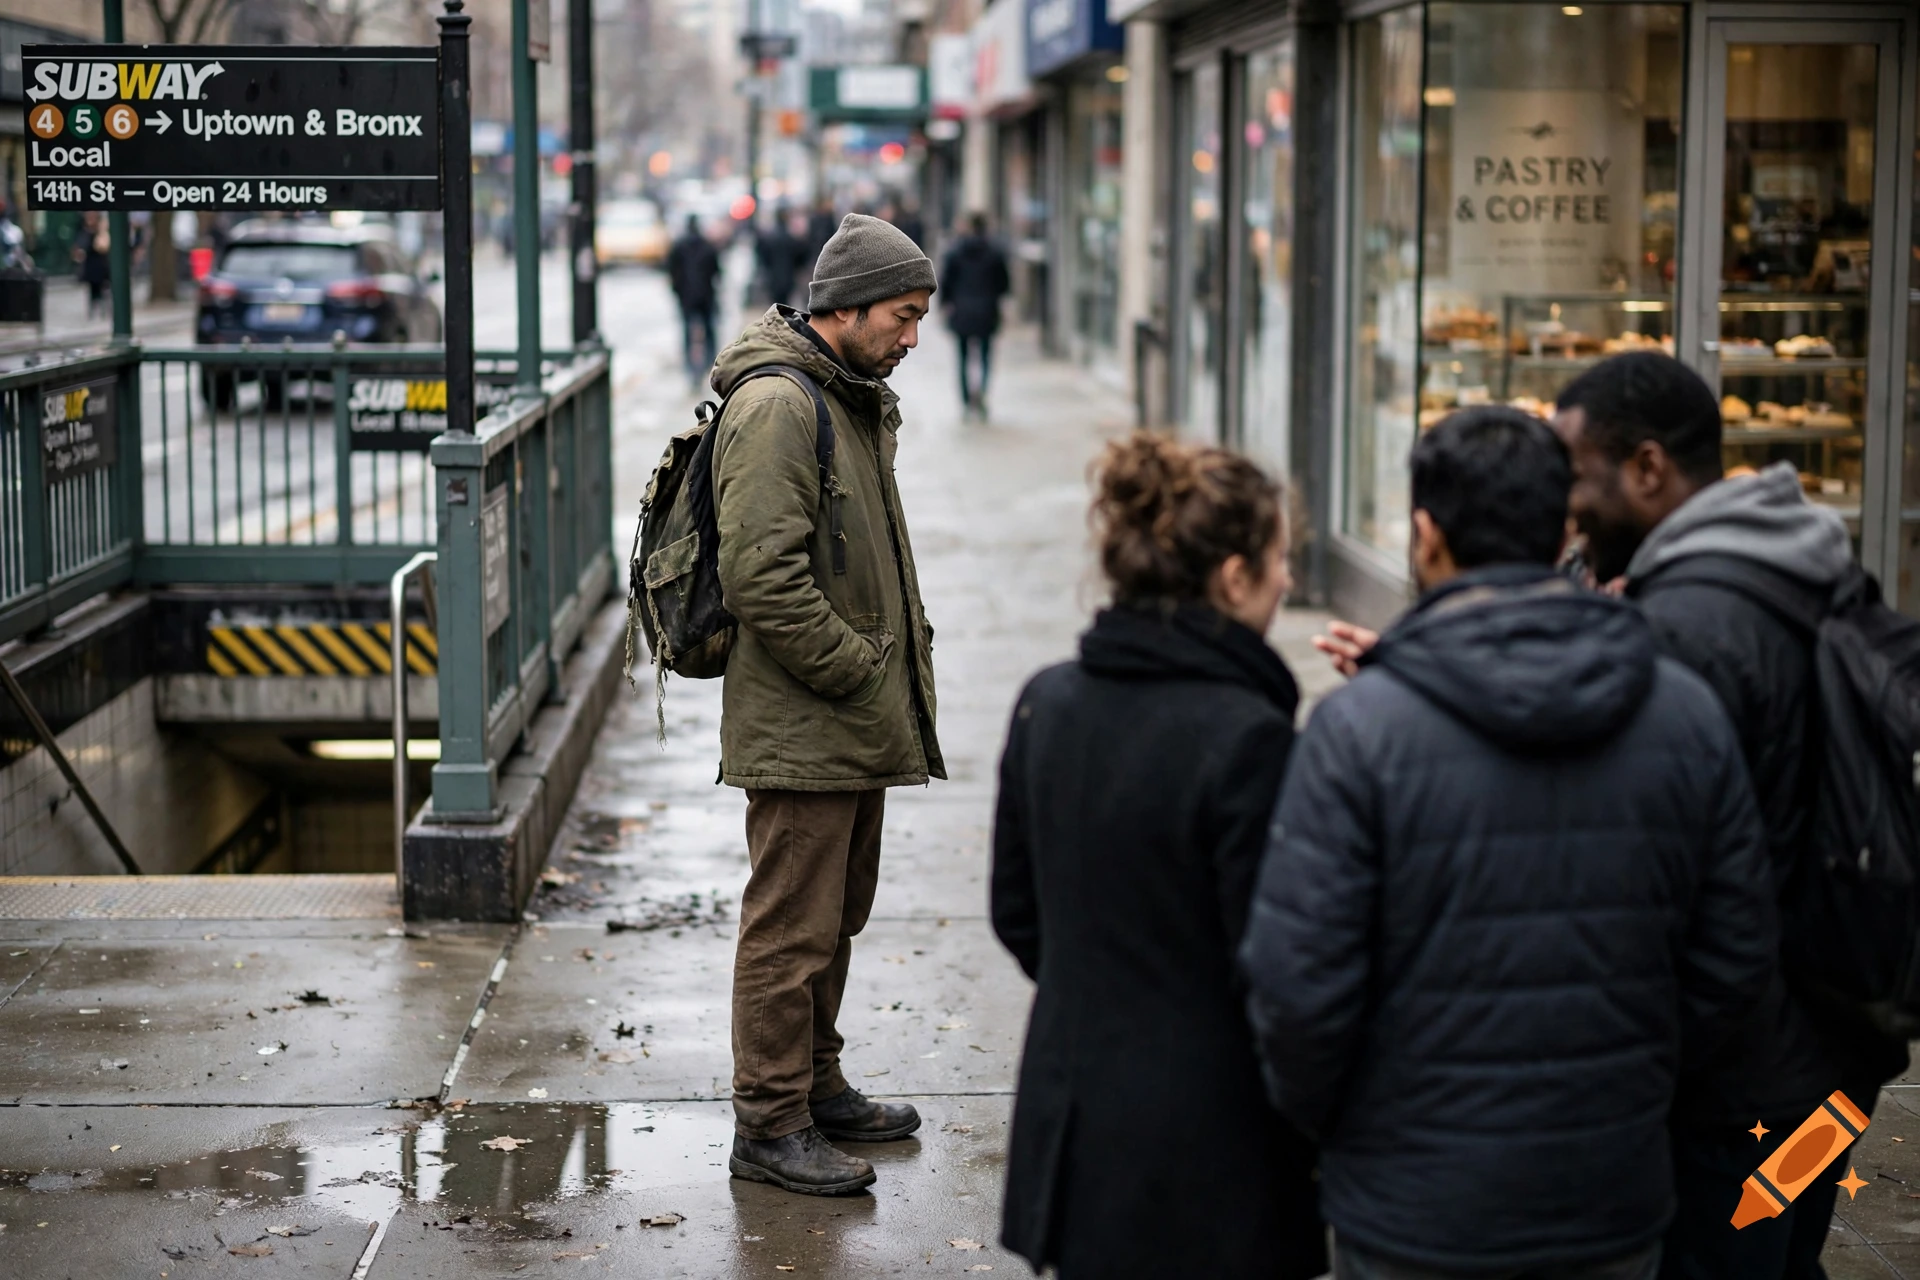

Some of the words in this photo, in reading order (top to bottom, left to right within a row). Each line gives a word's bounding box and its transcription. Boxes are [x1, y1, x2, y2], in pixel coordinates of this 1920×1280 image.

[25, 61, 225, 103] SUBWAY
[36, 109, 55, 133] 4
[75, 109, 94, 134] 5
[112, 109, 132, 134] 6
[182, 108, 295, 141] Uptown
[304, 108, 327, 136] &
[336, 109, 423, 136] Bronx
[32, 141, 110, 167] Local
[1474, 156, 1611, 186] PASTRY
[33, 181, 81, 202] 14th
[90, 181, 115, 203] St
[153, 181, 215, 207] Open
[222, 182, 251, 203] 24
[259, 182, 327, 203] Hours
[1456, 195, 1476, 223] &
[1485, 195, 1611, 223] COFFEE
[348, 379, 447, 411] SUBWA
